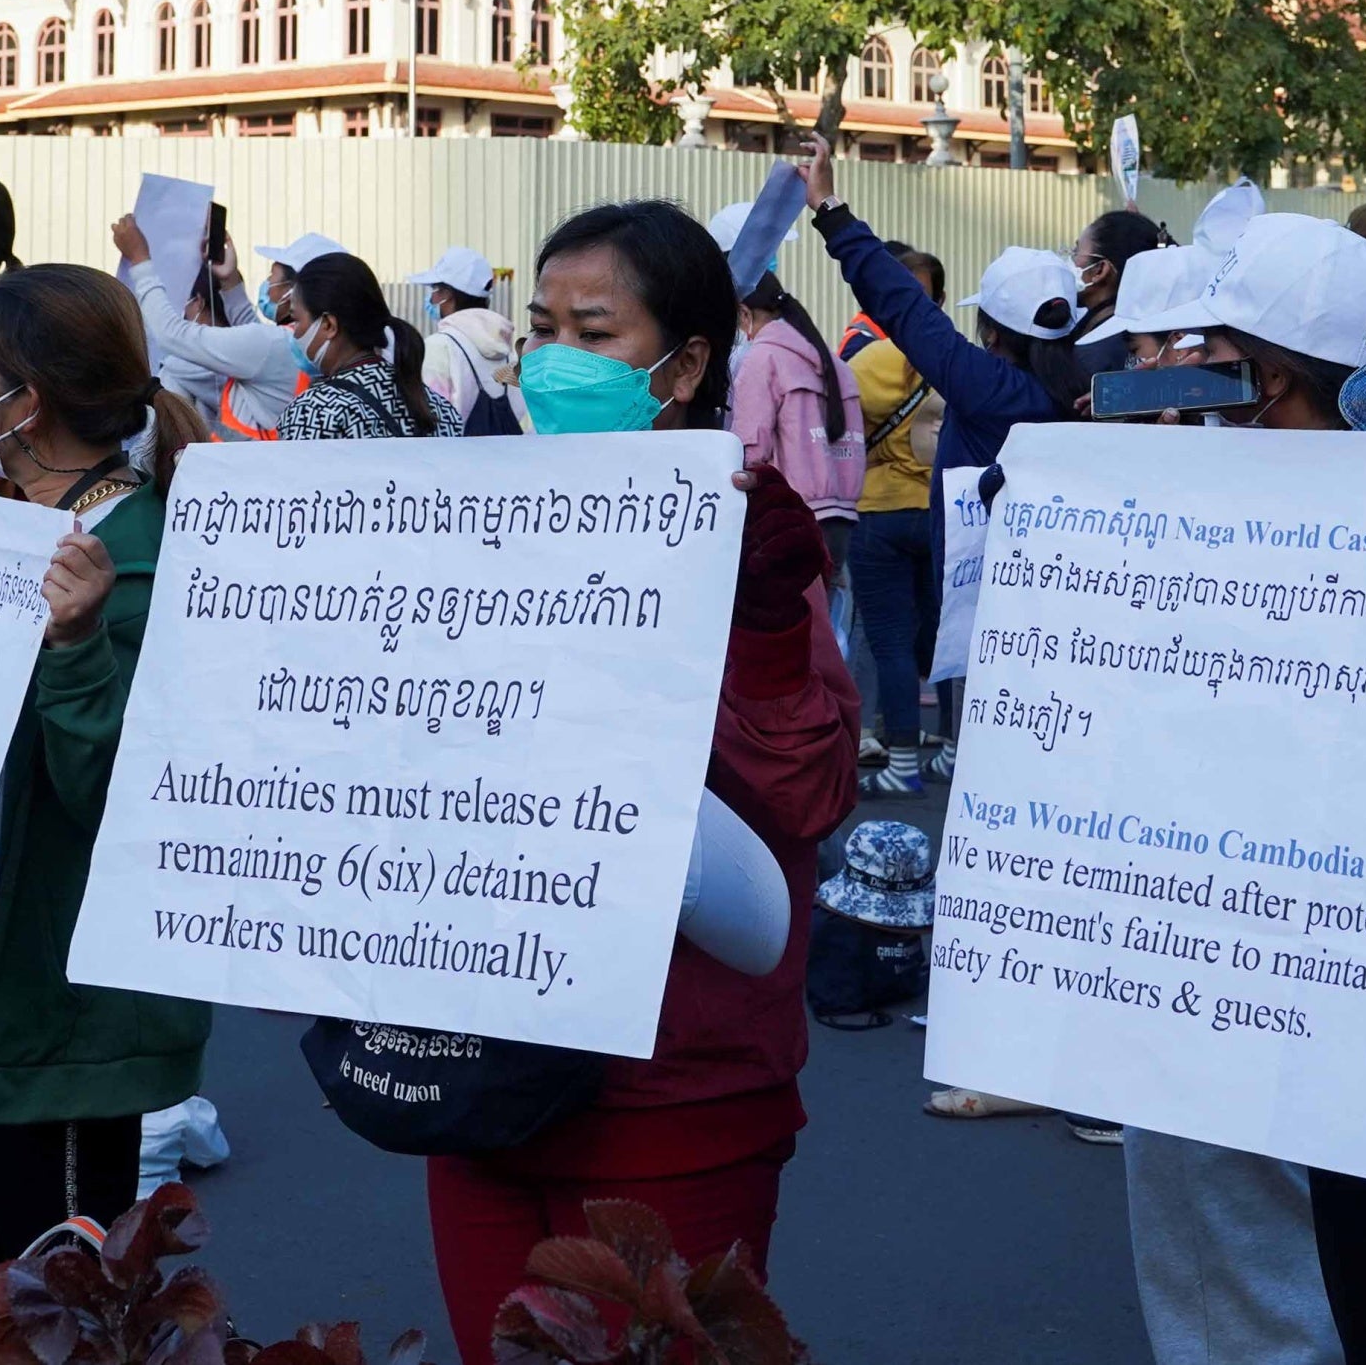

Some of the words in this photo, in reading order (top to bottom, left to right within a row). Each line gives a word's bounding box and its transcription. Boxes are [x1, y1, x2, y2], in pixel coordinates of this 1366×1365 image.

[1175, 516, 1235, 549] Naga
[1245, 520, 1321, 549] World
[151, 760, 335, 813] Authorities
[346, 780, 431, 819] must
[439, 777, 561, 828] release
[573, 785, 639, 835] the
[959, 792, 1017, 831] Naga
[1028, 801, 1113, 841] World
[1118, 815, 1209, 855] Casino
[1218, 830, 1364, 878] Cambodia
[158, 834, 327, 896] remaining
[337, 843, 435, 905] 6(six)
[443, 850, 601, 909] detained
[947, 835, 978, 869] We
[986, 849, 1054, 881] were
[1062, 857, 1214, 908] terminated
[1221, 880, 1297, 921] after
[155, 904, 284, 953] workers
[298, 920, 573, 996] unconditionally.
[938, 894, 1113, 946] management's
[1122, 916, 1221, 964] failure
[1232, 938, 1261, 971] to
[933, 938, 991, 984] safety
[998, 947, 1044, 985] for
[1053, 966, 1162, 1009] workers
[1171, 981, 1202, 1017] &
[1211, 997, 1312, 1038] guests.
[353, 1065, 391, 1096] need
